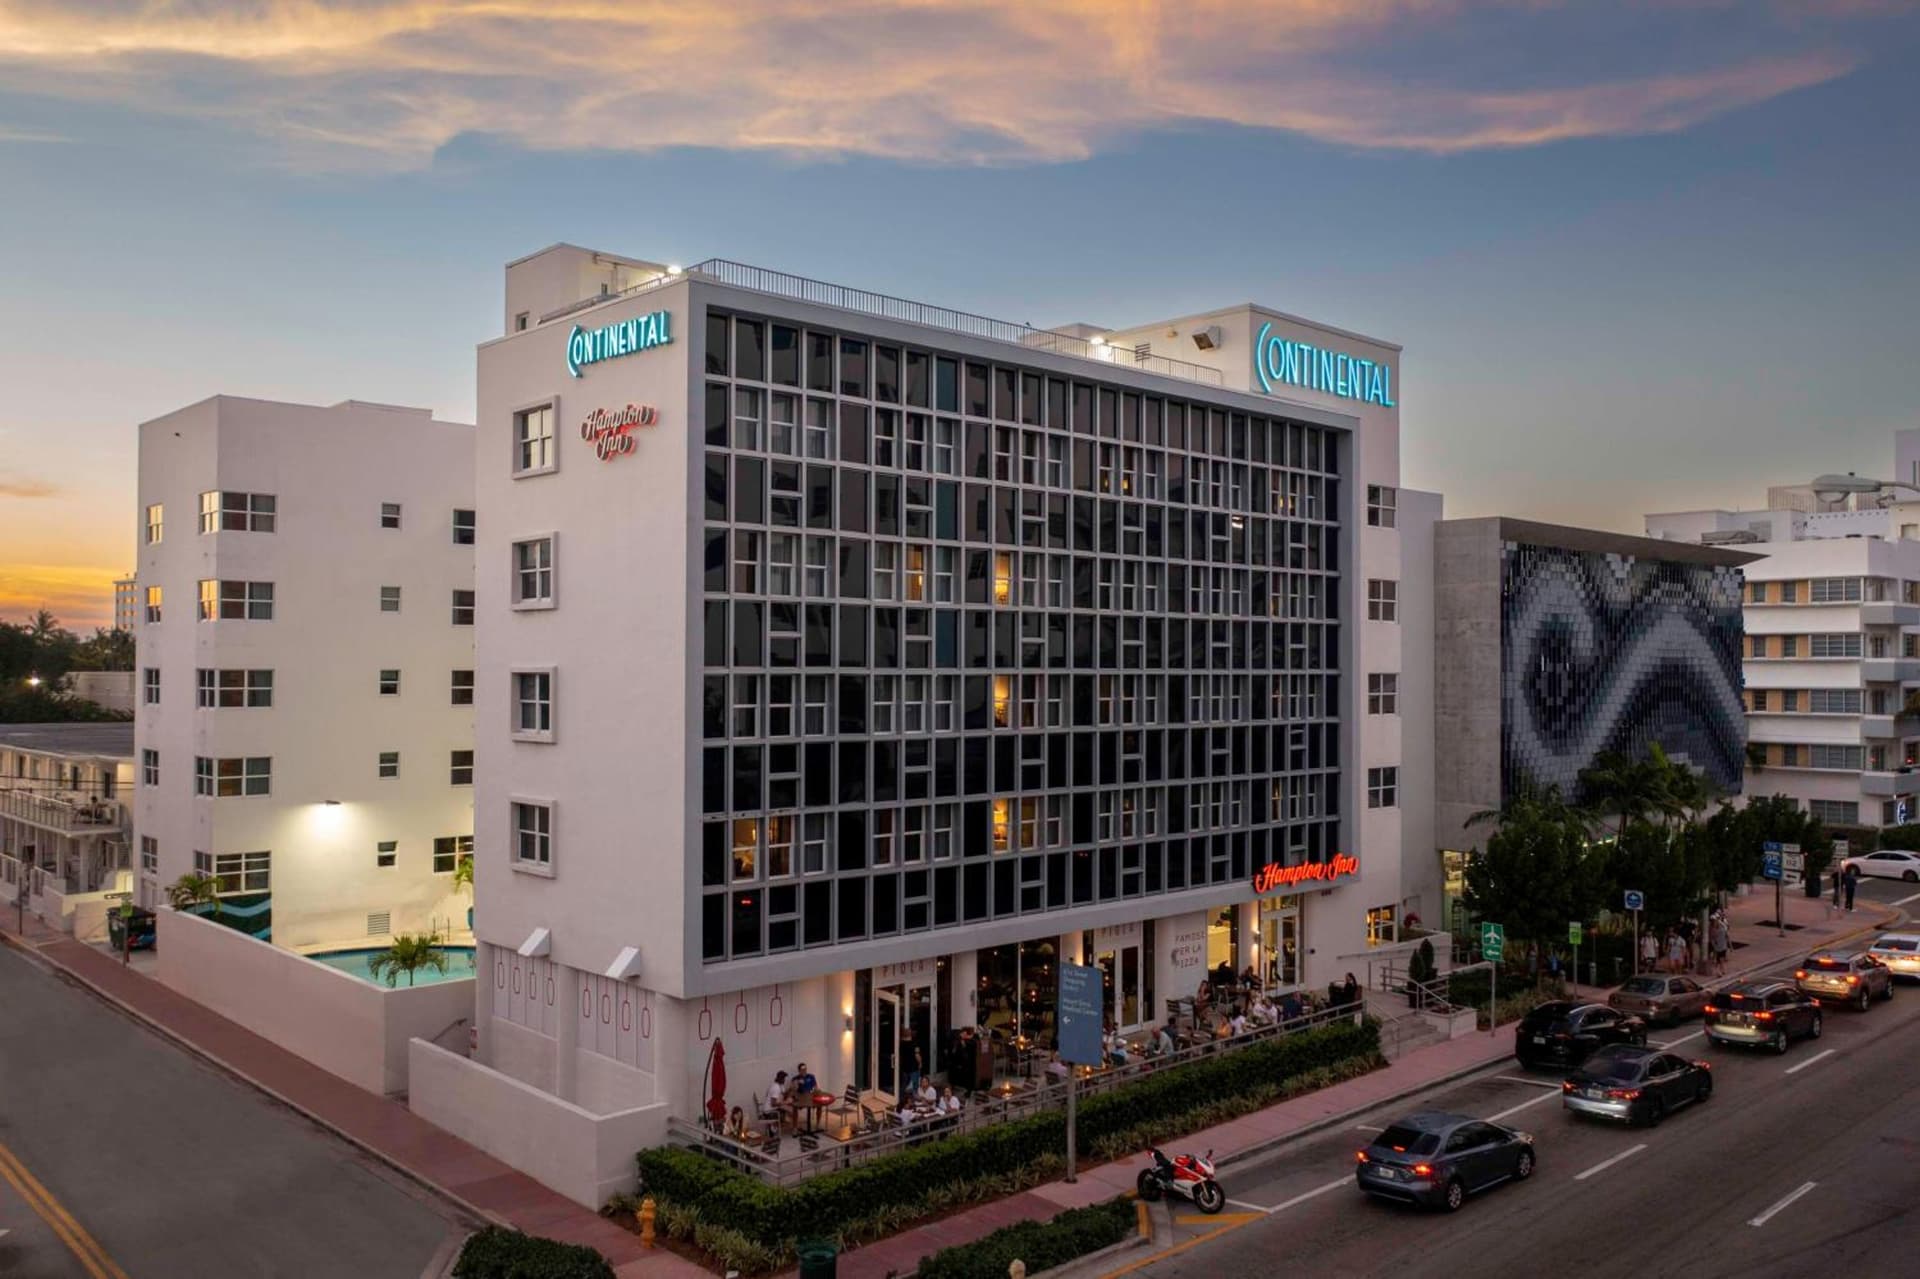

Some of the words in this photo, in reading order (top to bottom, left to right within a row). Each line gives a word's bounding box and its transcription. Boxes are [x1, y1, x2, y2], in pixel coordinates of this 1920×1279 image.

[567, 309, 674, 378] CONTINENTAL
[1256, 323, 1395, 407] CONTINENTAL
[581, 404, 658, 441] Hampton
[596, 430, 638, 461] Inn
[1254, 860, 1327, 894] Hampton
[1327, 853, 1360, 881] Inn
